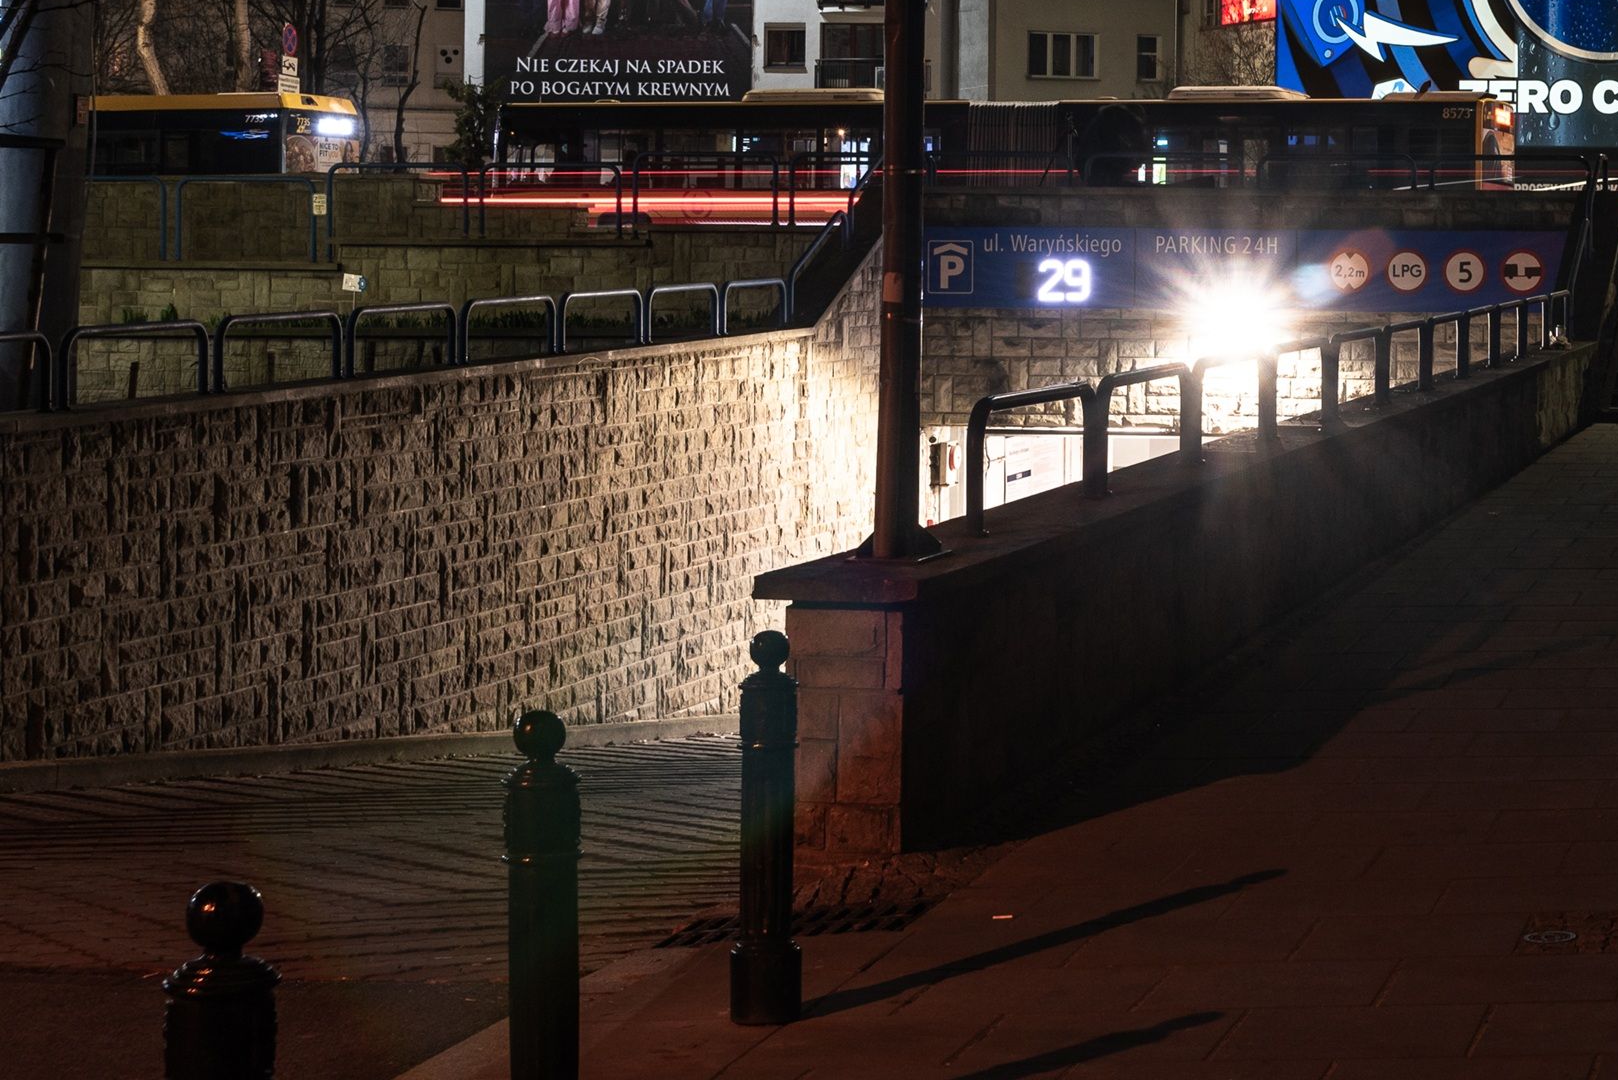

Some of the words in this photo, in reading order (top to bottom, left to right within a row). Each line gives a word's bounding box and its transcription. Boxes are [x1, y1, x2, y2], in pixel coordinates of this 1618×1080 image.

[516, 56, 549, 73] NIE
[555, 58, 619, 77] CZEKAJ
[626, 59, 651, 74] NA
[657, 59, 725, 75] SPADEK
[510, 80, 535, 95] PO
[541, 81, 630, 96] BOGATYM
[637, 82, 731, 97] KREWNYM
[1442, 107, 1471, 119] 8573
[984, 232, 1004, 252] ul.
[1011, 233, 1122, 257] Waryńskiego
[1156, 236, 1236, 254] PARKING
[1242, 236, 1278, 254] 24H
[940, 256, 965, 289] P
[1335, 264, 1365, 280] 2,2m
[1392, 264, 1422, 278] LPG
[1459, 261, 1473, 284] 5
[1037, 259, 1092, 303] 29
